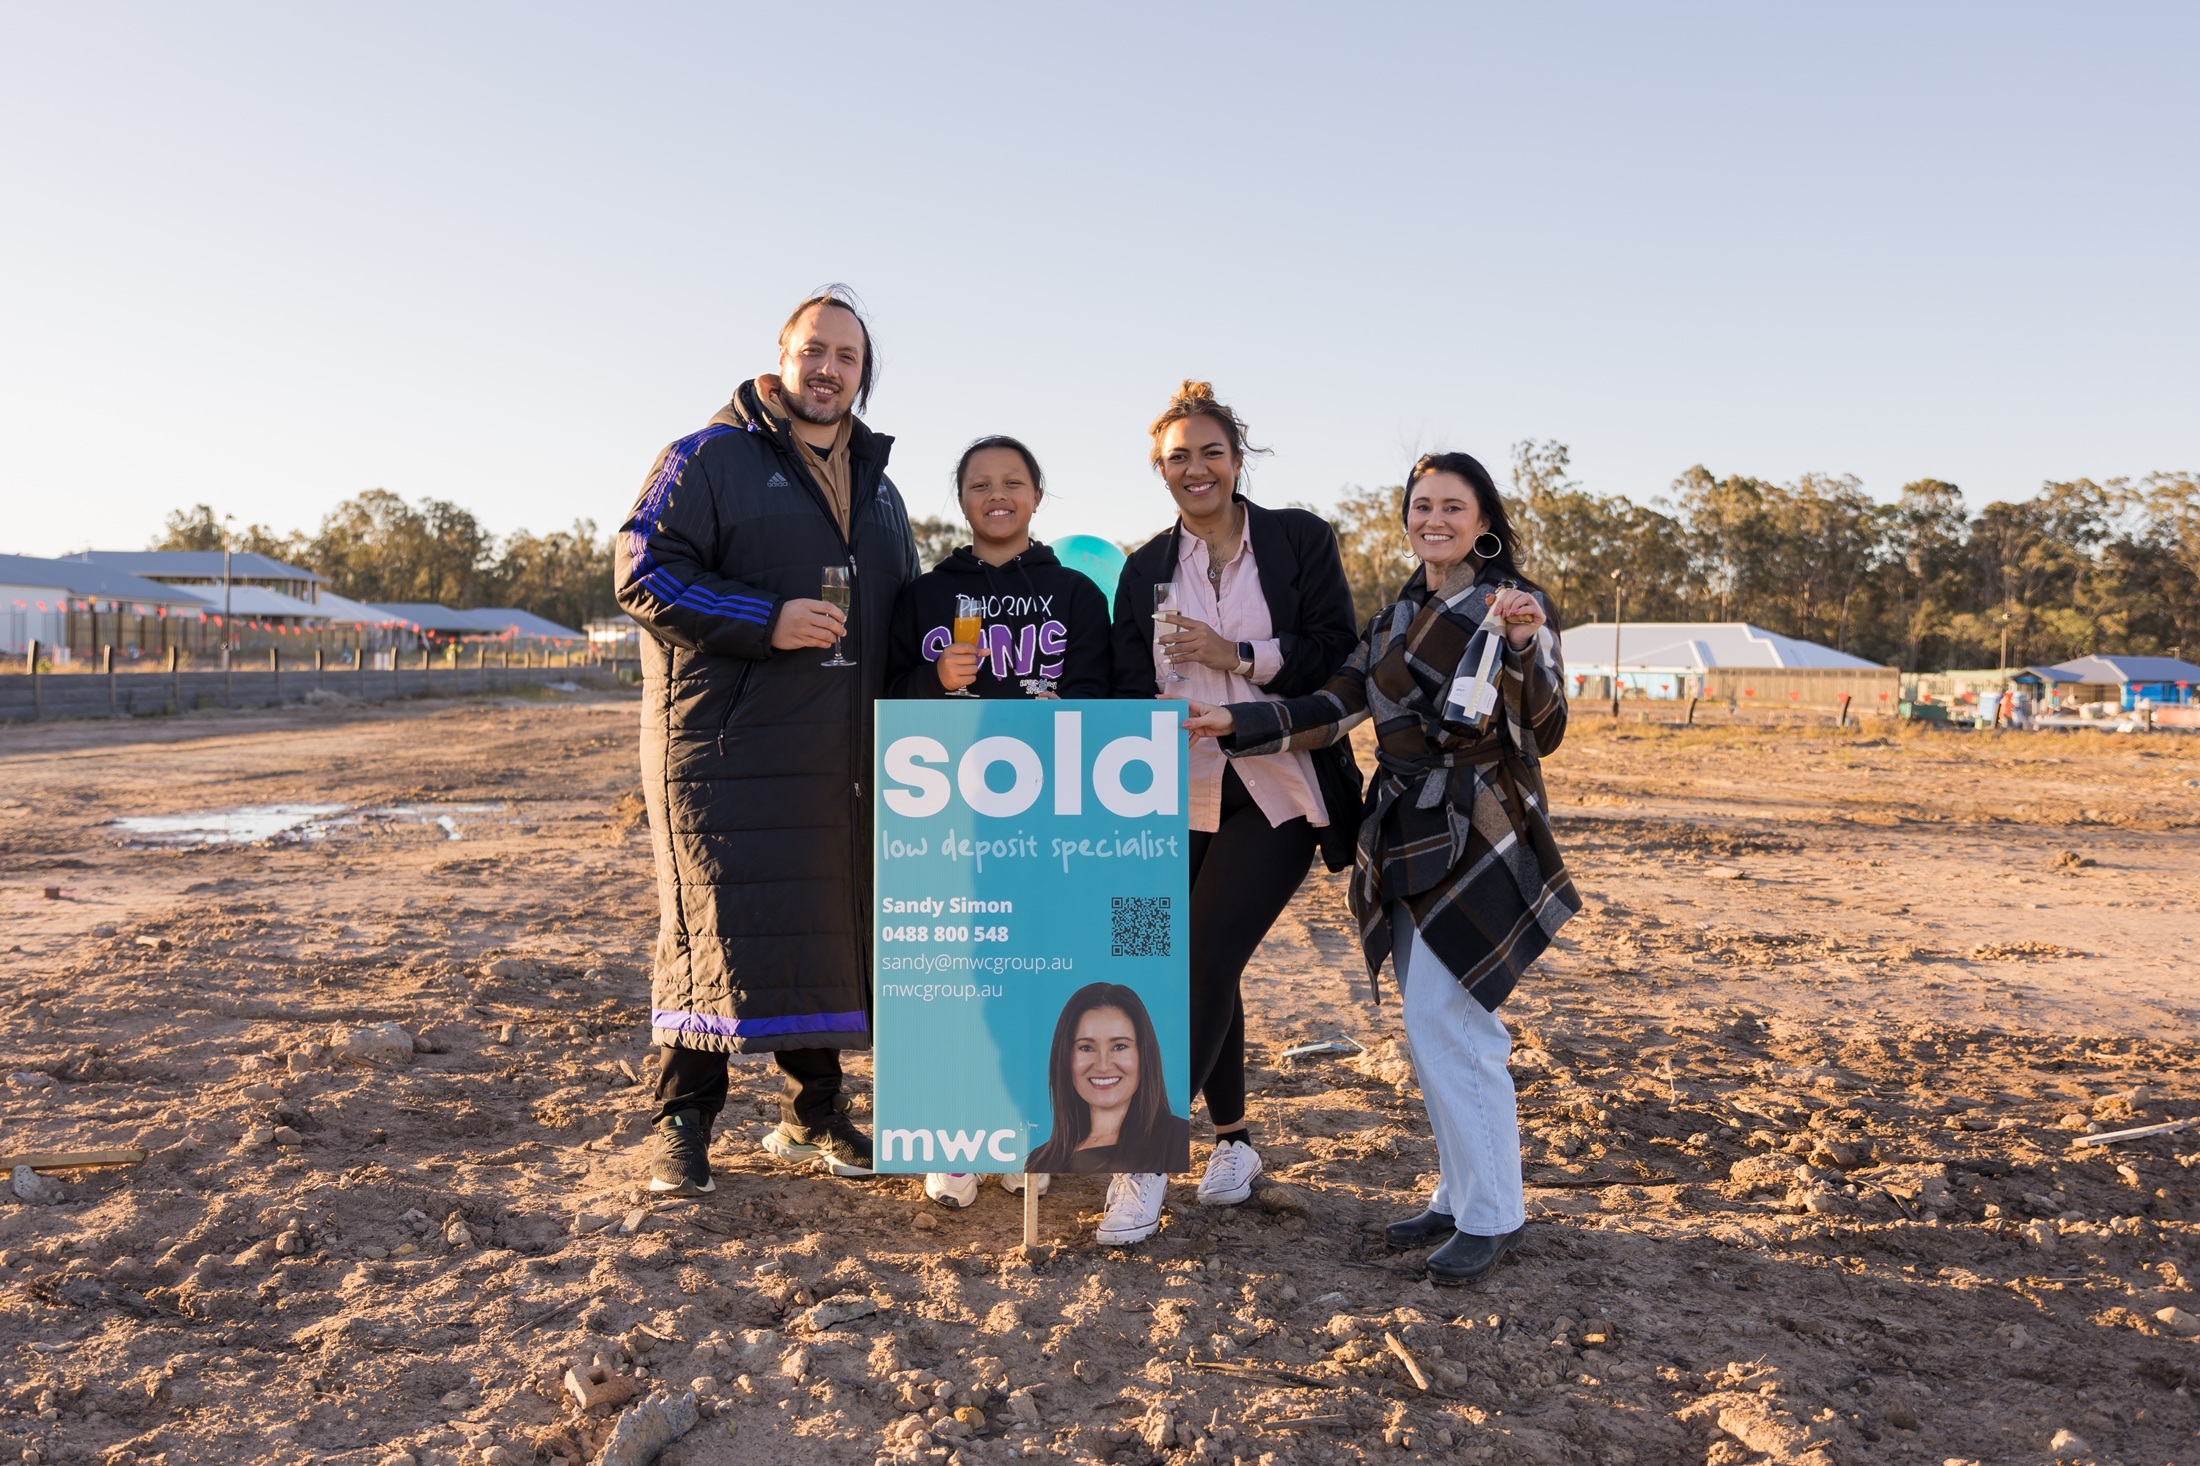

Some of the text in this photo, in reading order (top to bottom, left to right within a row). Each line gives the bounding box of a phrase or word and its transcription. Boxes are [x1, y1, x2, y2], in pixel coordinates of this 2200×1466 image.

[766, 480, 792, 488] adida
[882, 710, 1179, 818] sold
[882, 828, 1179, 874] low deposit specialist
[881, 896, 1013, 918] Sandy Simon
[881, 925, 1009, 943] 0488 800 548
[881, 953, 1073, 975] sandy@mwcgroup.au
[881, 983, 1004, 1002] mwcgroup.au
[881, 1128, 1017, 1162] mwc
